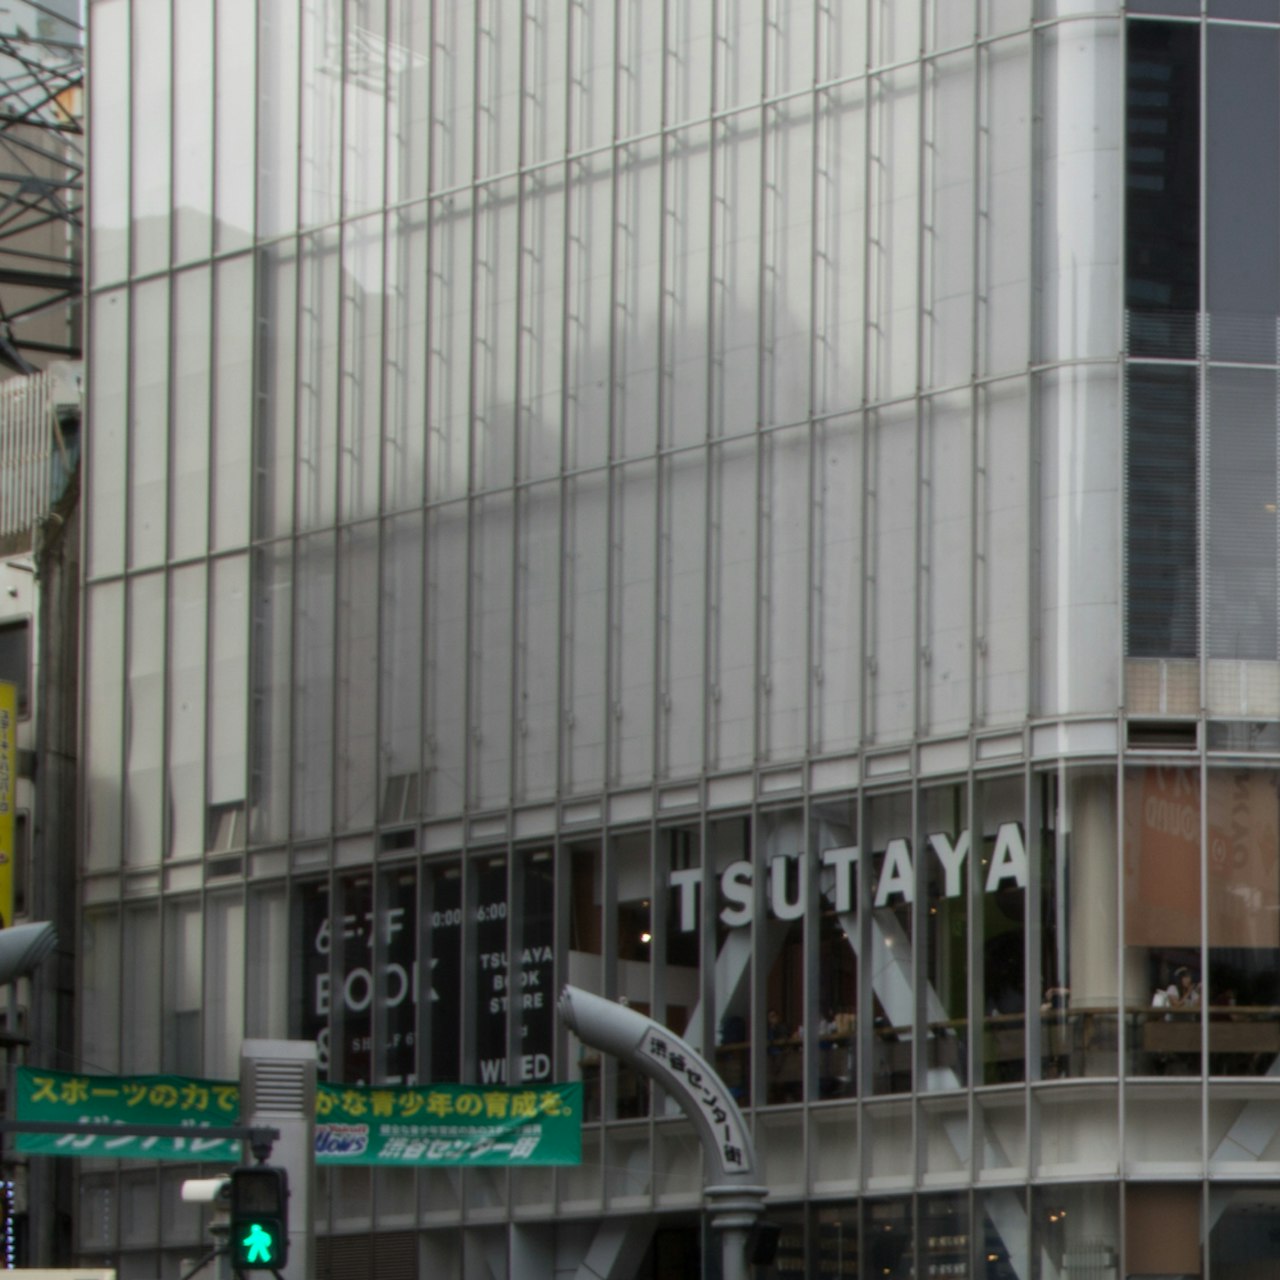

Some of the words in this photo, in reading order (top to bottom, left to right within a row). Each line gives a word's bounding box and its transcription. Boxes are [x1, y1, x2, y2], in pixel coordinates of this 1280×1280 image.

[670, 822, 1028, 932] TSUTAYA
[480, 946, 553, 970] TSUAYA
[489, 992, 545, 1015] STRE
[480, 1053, 552, 1084] WIED
